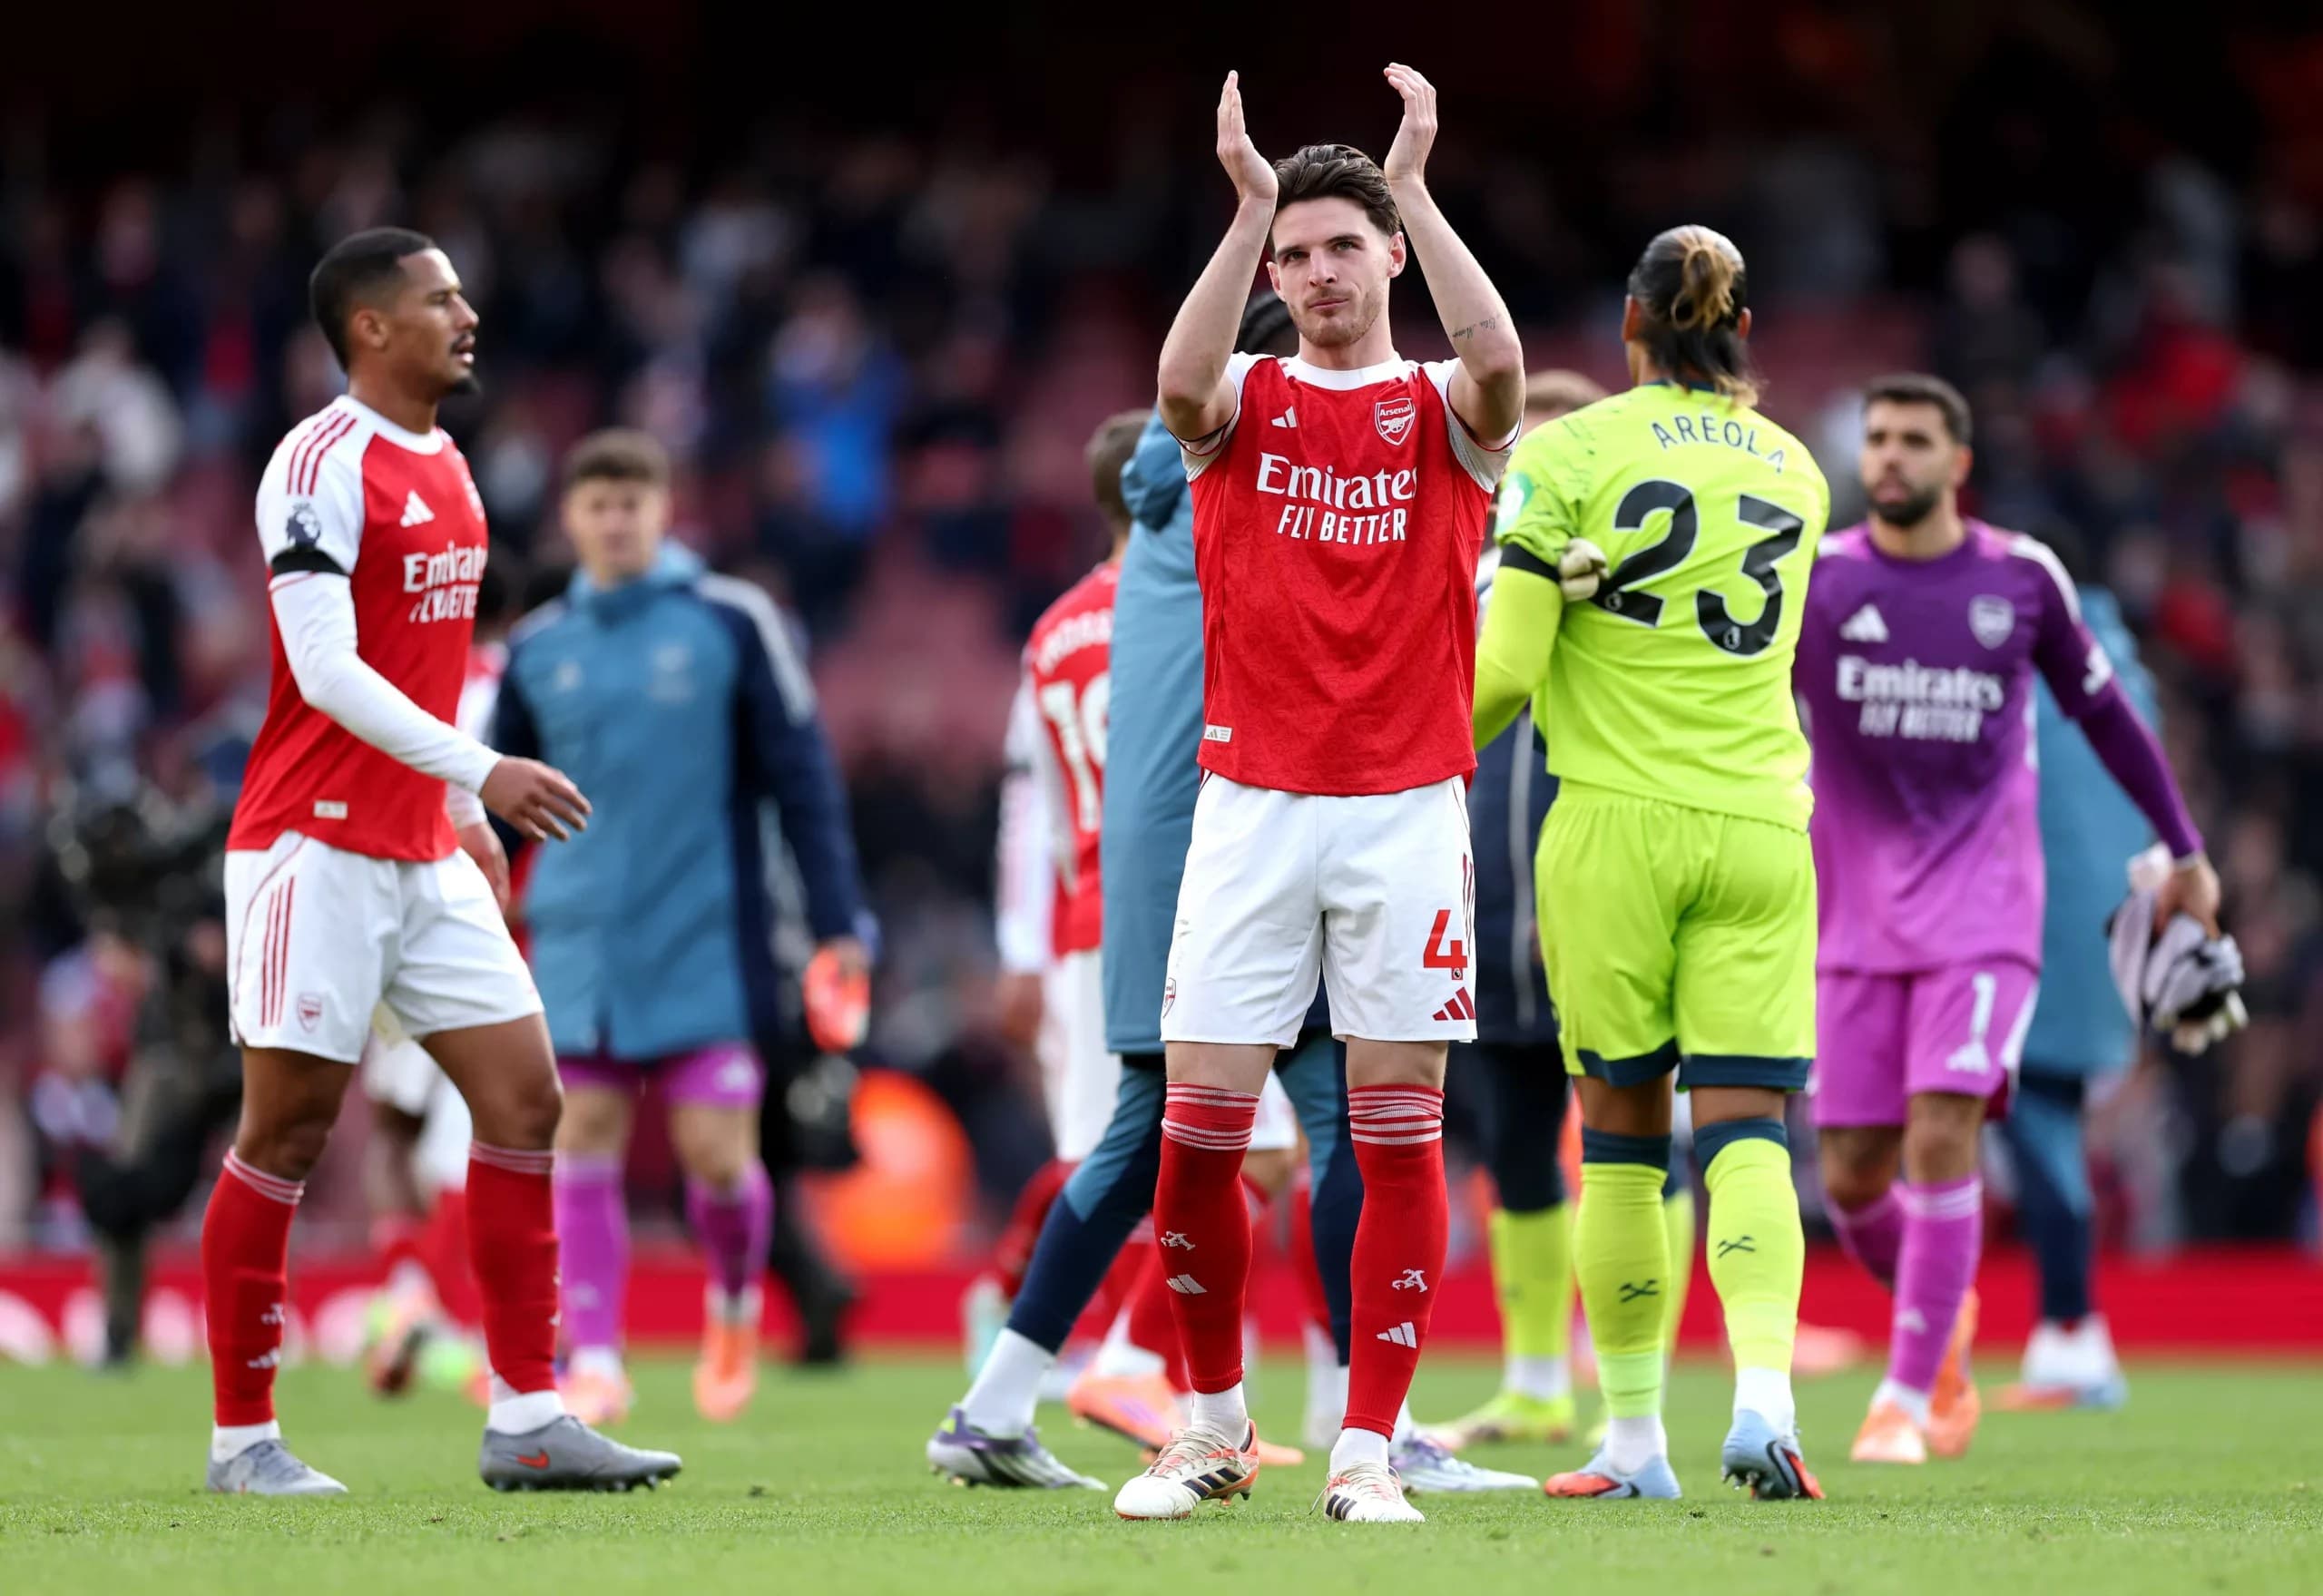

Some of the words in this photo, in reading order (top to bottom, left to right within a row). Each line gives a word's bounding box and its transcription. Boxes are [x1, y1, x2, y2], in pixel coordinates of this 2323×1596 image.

[1379, 404, 1412, 416] Arsenal
[1652, 415, 1785, 474] AREOLA
[1277, 504, 1315, 540] FLY
[1318, 508, 1407, 544] BETTER
[403, 539, 488, 593] Emirat
[1590, 479, 1805, 656] 23
[1423, 909, 1467, 980] 4
[1970, 973, 1995, 1041] 1
